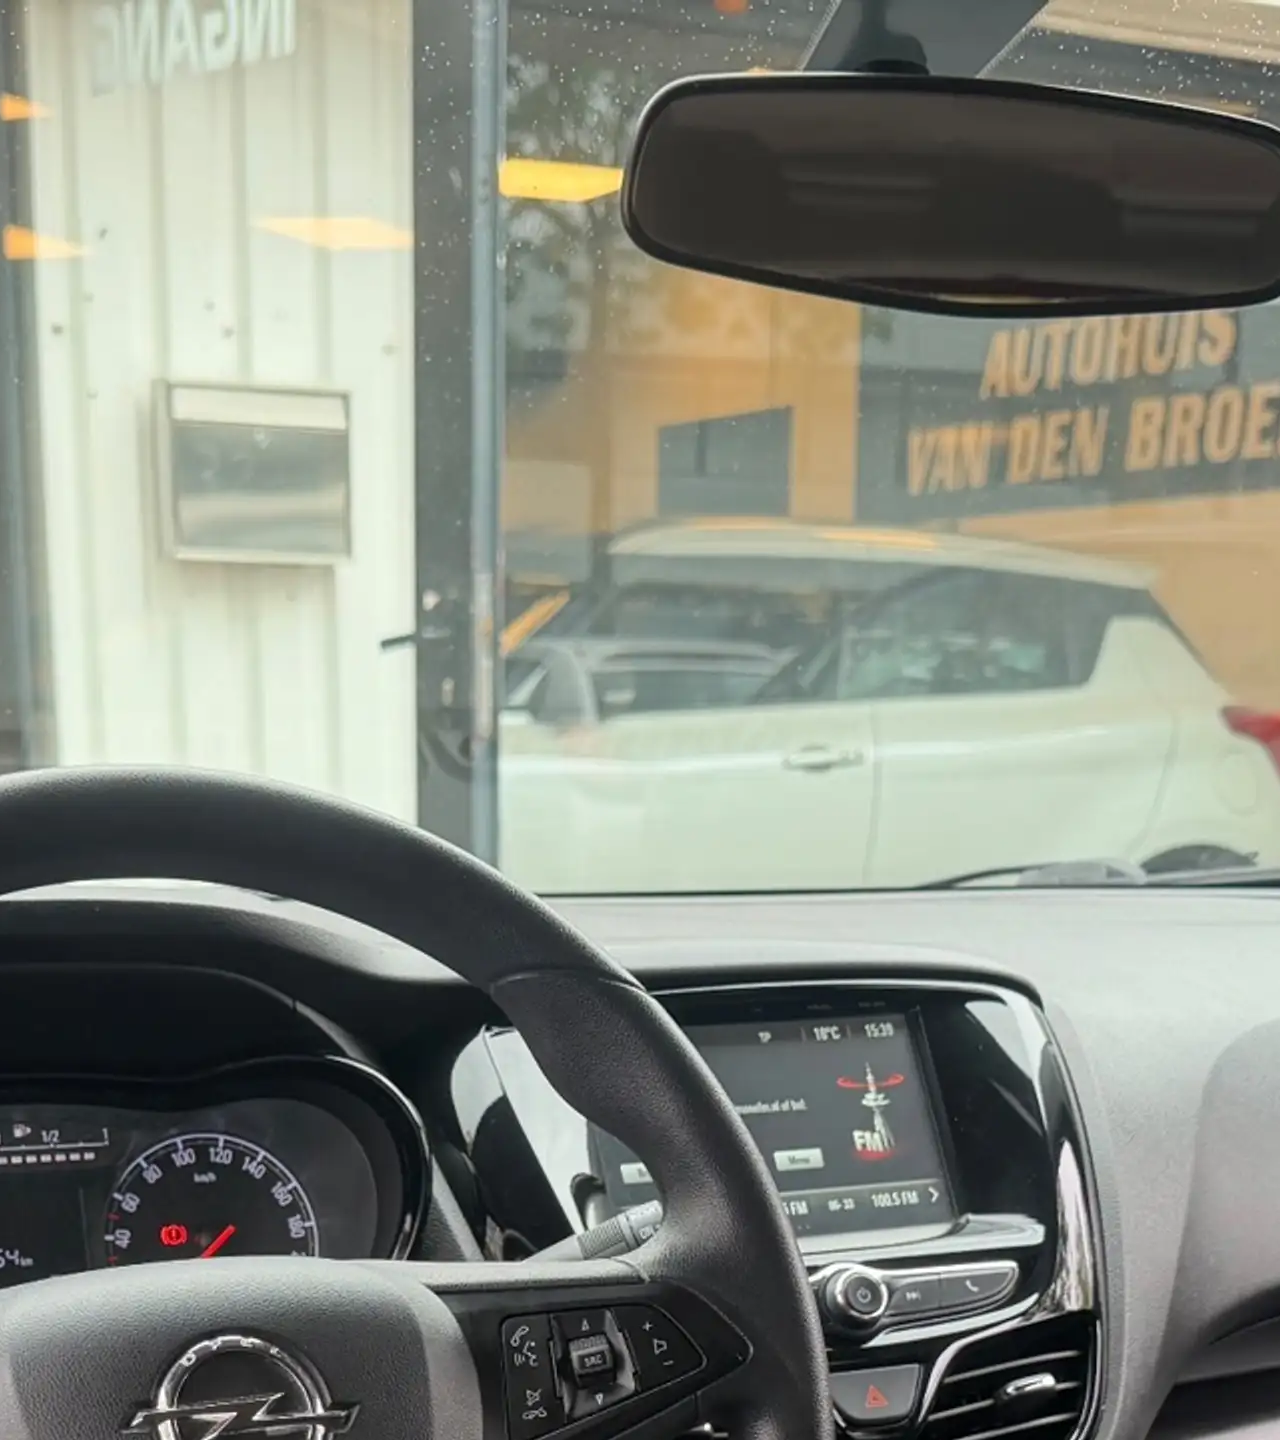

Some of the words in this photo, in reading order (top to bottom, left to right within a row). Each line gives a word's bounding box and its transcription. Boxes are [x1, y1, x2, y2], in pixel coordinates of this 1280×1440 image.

[979, 310, 1237, 399] AUTOHUIS
[907, 421, 992, 496] VAN
[1006, 406, 1110, 485] DEN
[42, 1129, 60, 1143] 1/2
[852, 1130, 880, 1152] FM
[171, 1147, 196, 1168] 100
[209, 1147, 232, 1164] 120
[142, 1164, 163, 1184] 80
[241, 1156, 266, 1180] 140
[121, 1192, 141, 1213] 60
[271, 1181, 293, 1206] 160
[871, 1192, 901, 1208] 100.5
[901, 1188, 920, 1205] FM
[287, 1213, 306, 1239] 180
[114, 1228, 132, 1250] 40
